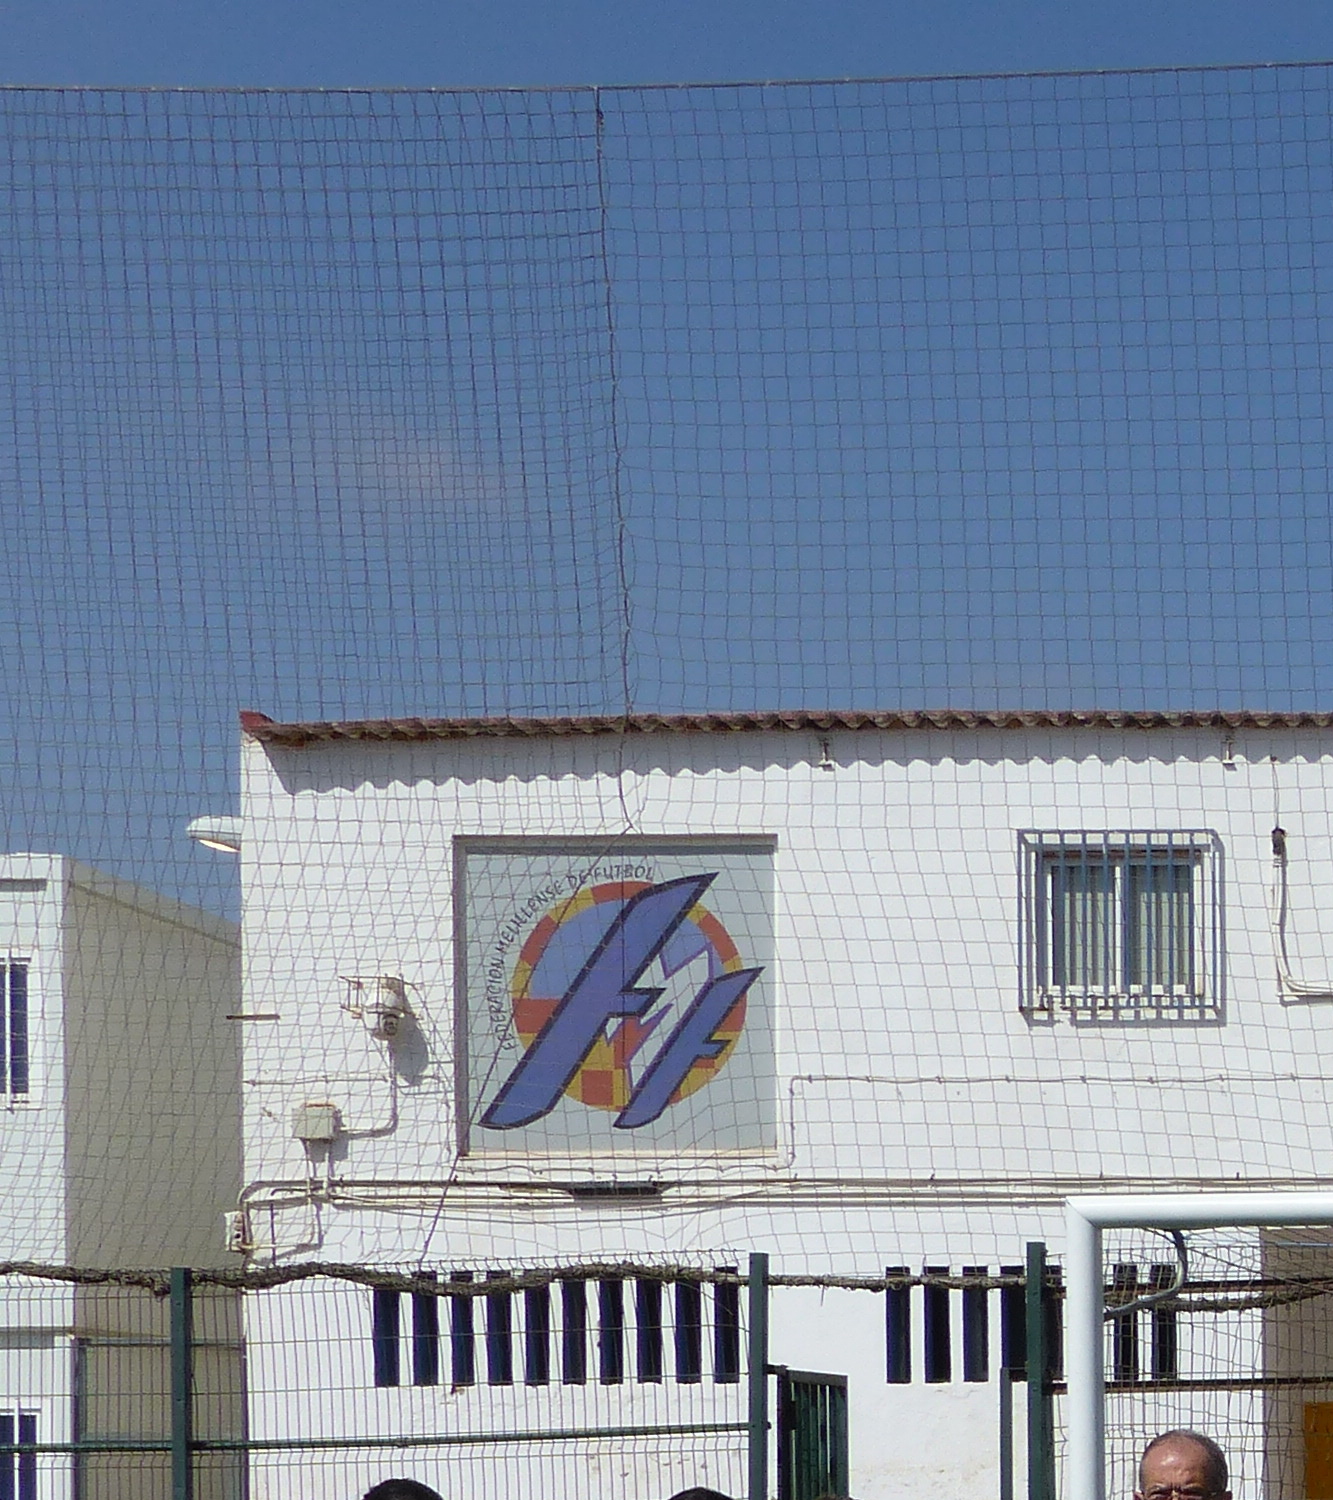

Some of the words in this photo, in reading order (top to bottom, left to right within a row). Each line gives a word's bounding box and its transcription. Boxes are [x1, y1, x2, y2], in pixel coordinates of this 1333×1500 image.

[567, 872, 587, 889] DE
[590, 864, 655, 882] FUTBOL
[497, 879, 563, 955] MELILLENSE
[486, 958, 518, 1052] FEDERACION
